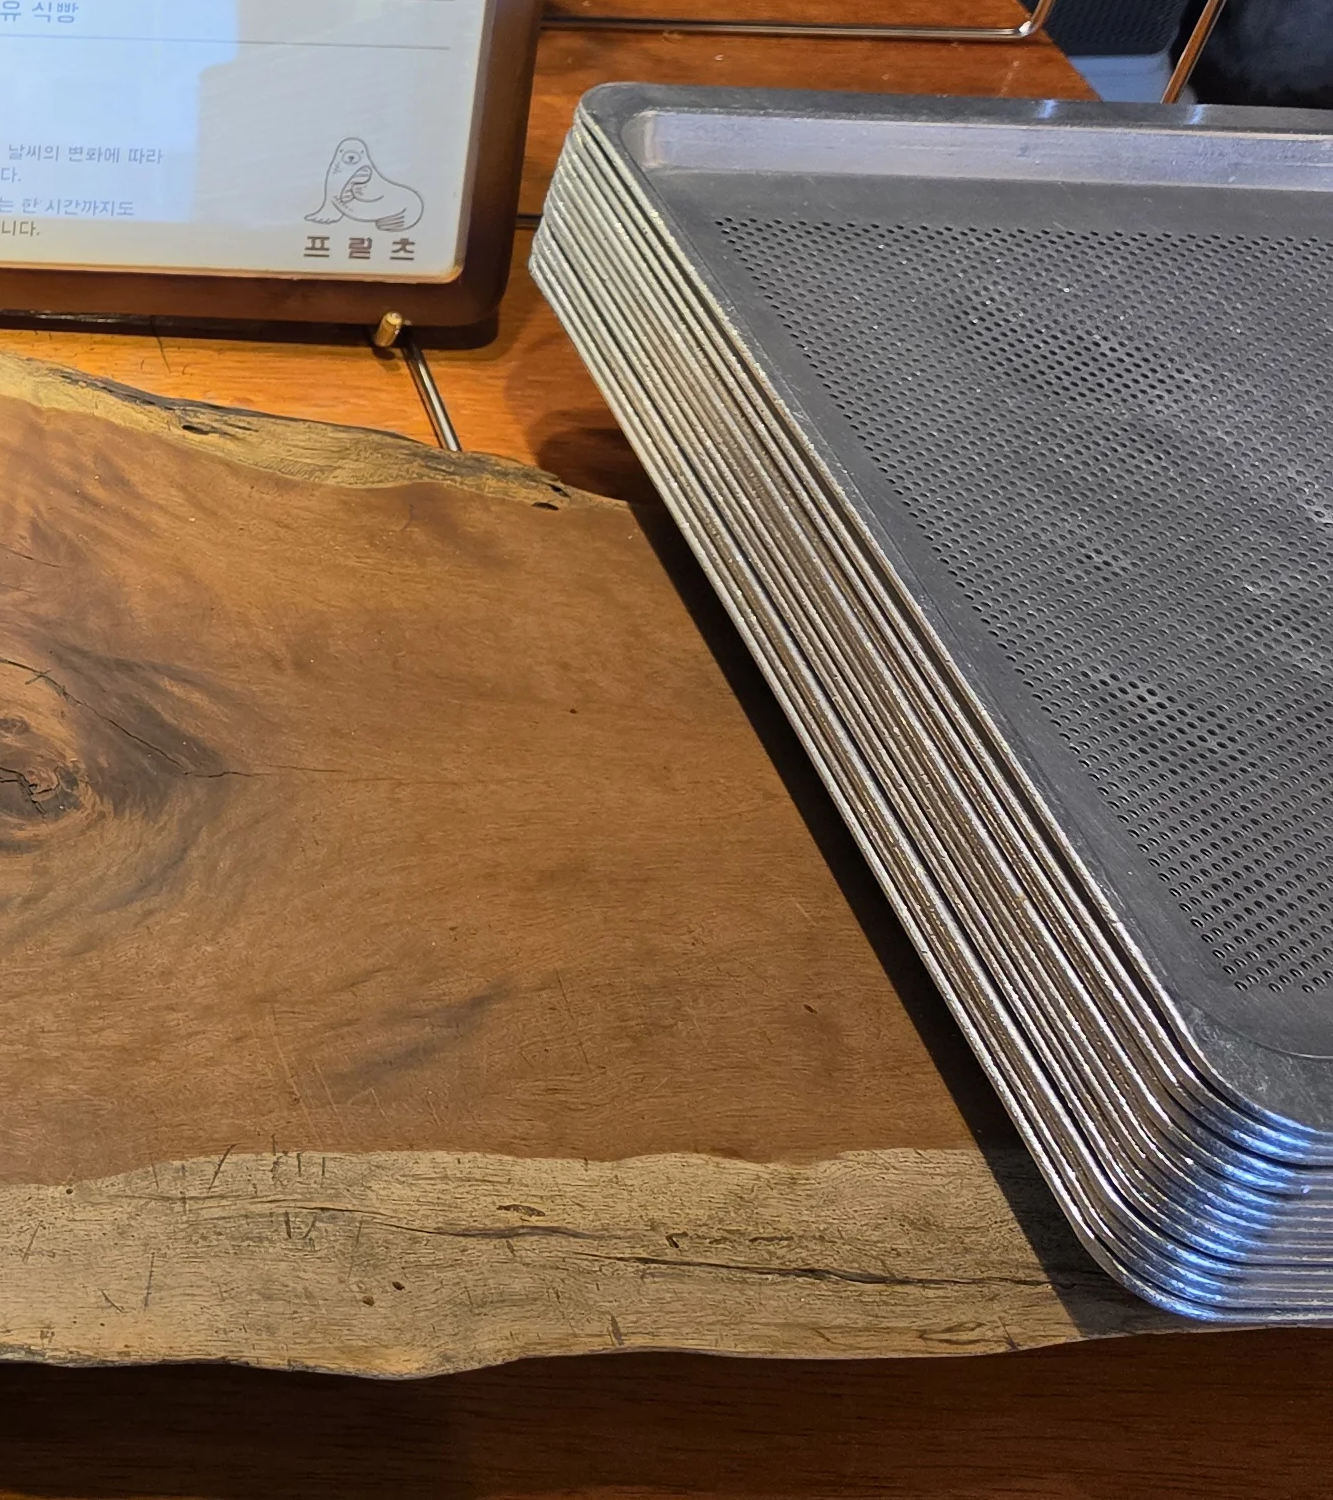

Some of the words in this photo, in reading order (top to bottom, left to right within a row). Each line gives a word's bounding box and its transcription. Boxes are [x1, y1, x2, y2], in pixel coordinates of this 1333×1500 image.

[32, 2, 79, 24] 식빵
[9, 144, 60, 161] 날씨의
[68, 146, 120, 163] 변화에
[128, 148, 165, 165] 따라
[22, 198, 39, 214] 한
[45, 199, 135, 217] 시간까지도
